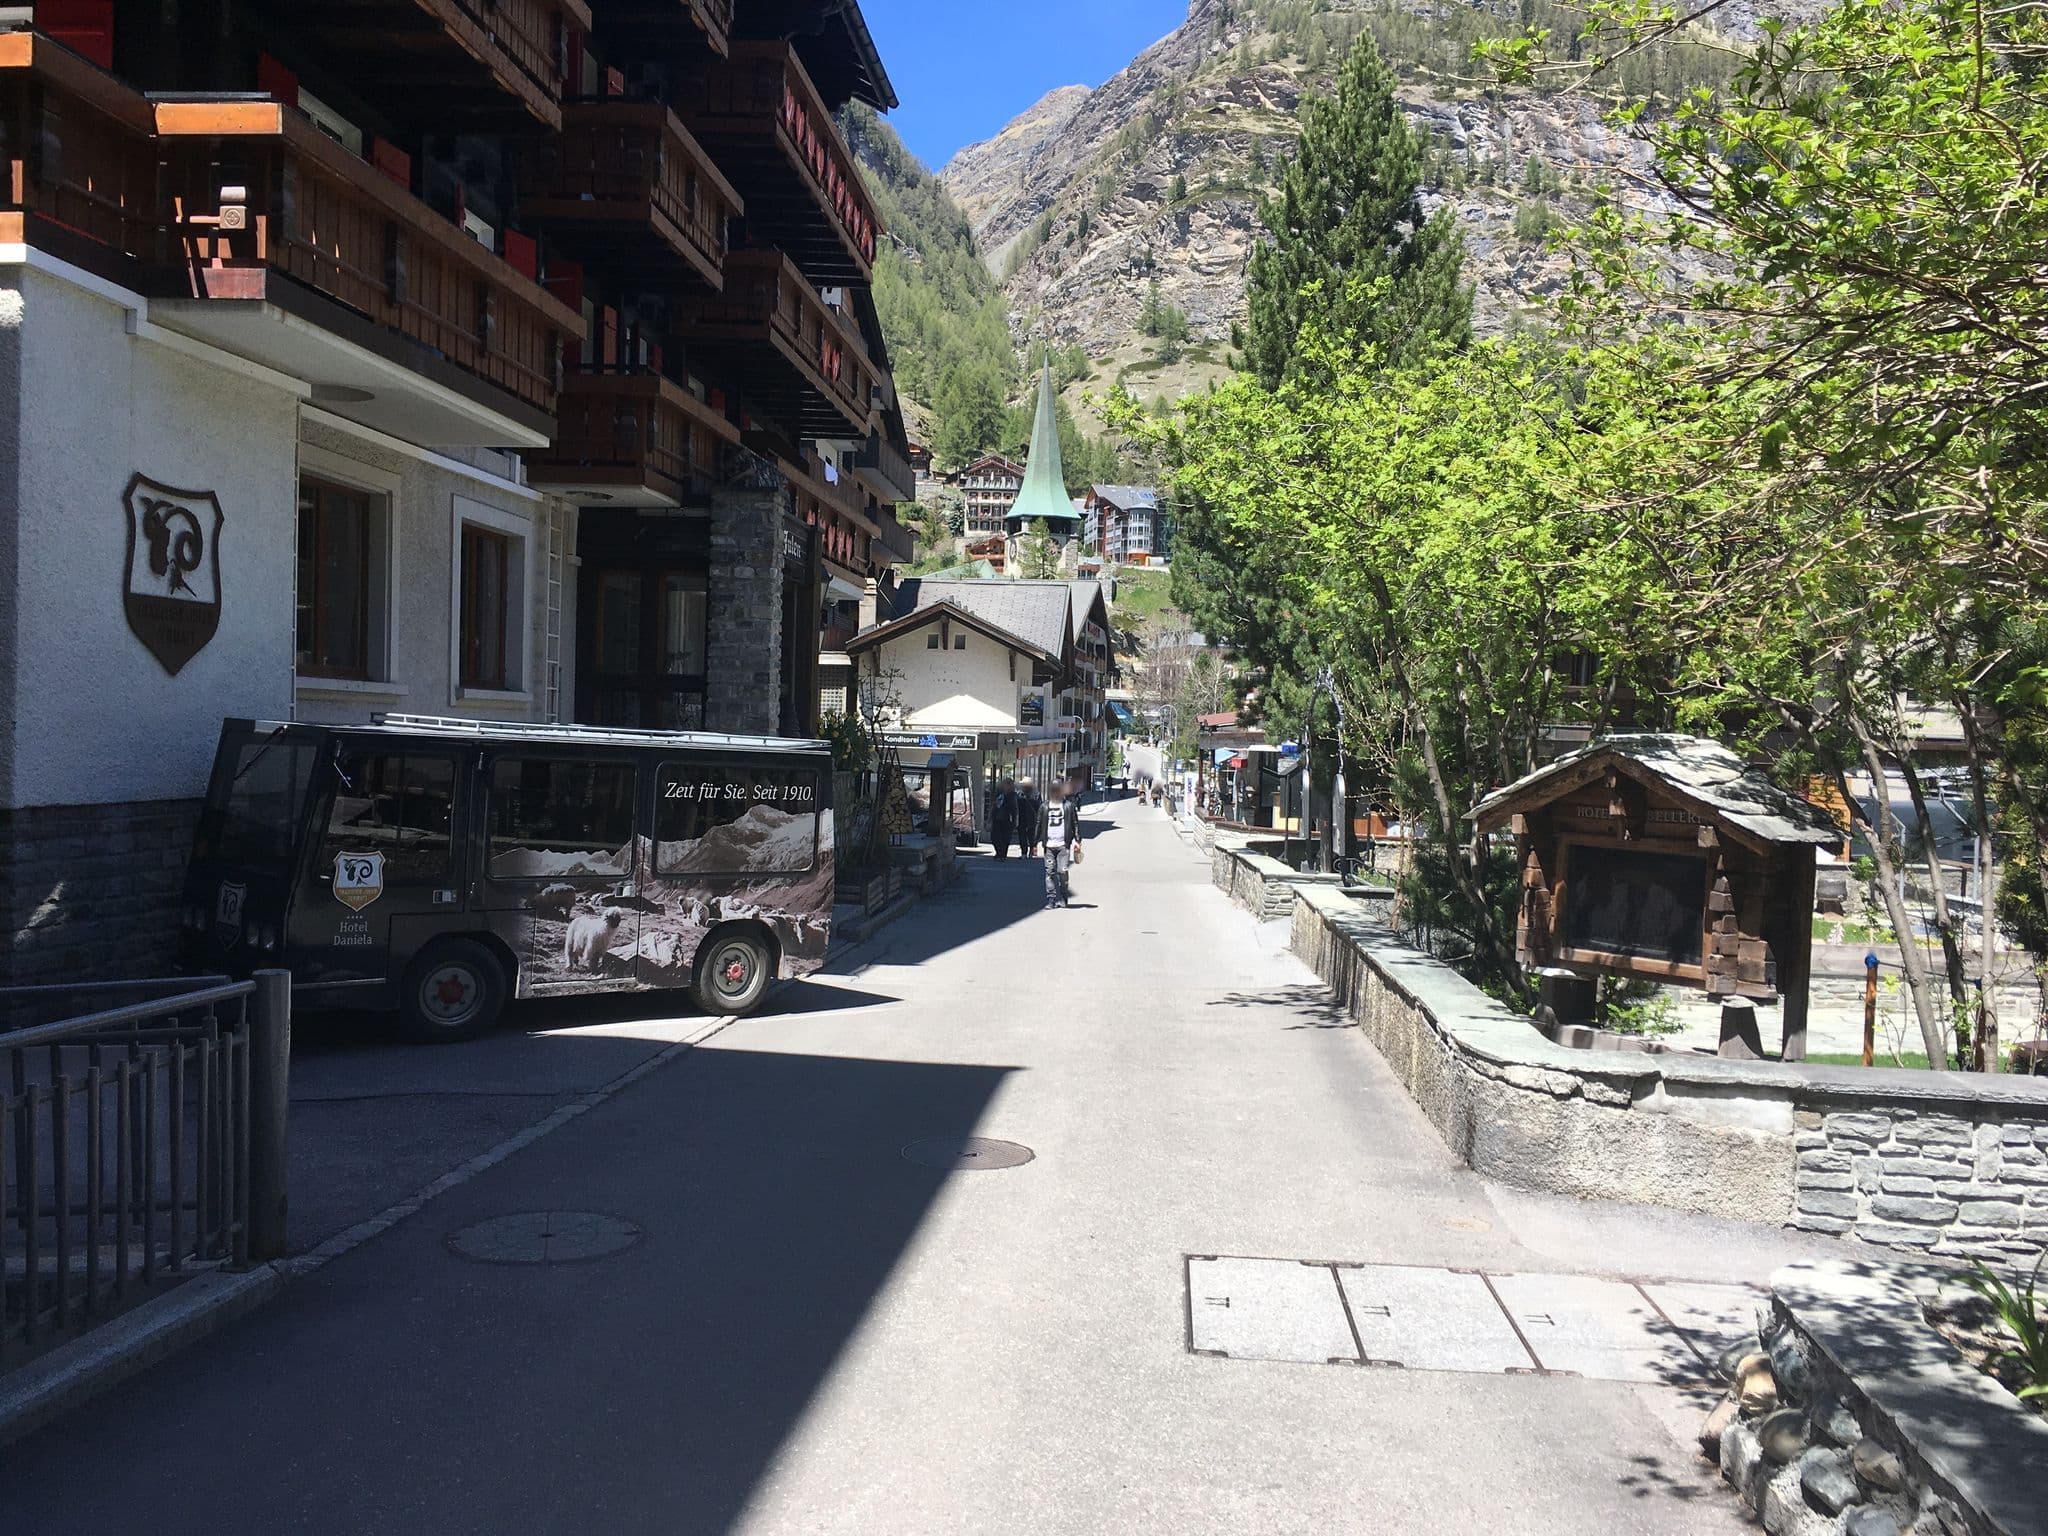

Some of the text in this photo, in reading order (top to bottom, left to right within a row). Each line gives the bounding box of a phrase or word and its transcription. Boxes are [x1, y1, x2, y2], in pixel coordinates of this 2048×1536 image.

[783, 529, 801, 559] Julen
[883, 735, 920, 745] Konditorei
[664, 782, 814, 803] Zeit für Sie. Seit 1910.
[339, 921, 368, 933] Hotel
[333, 934, 373, 946] Daniela
